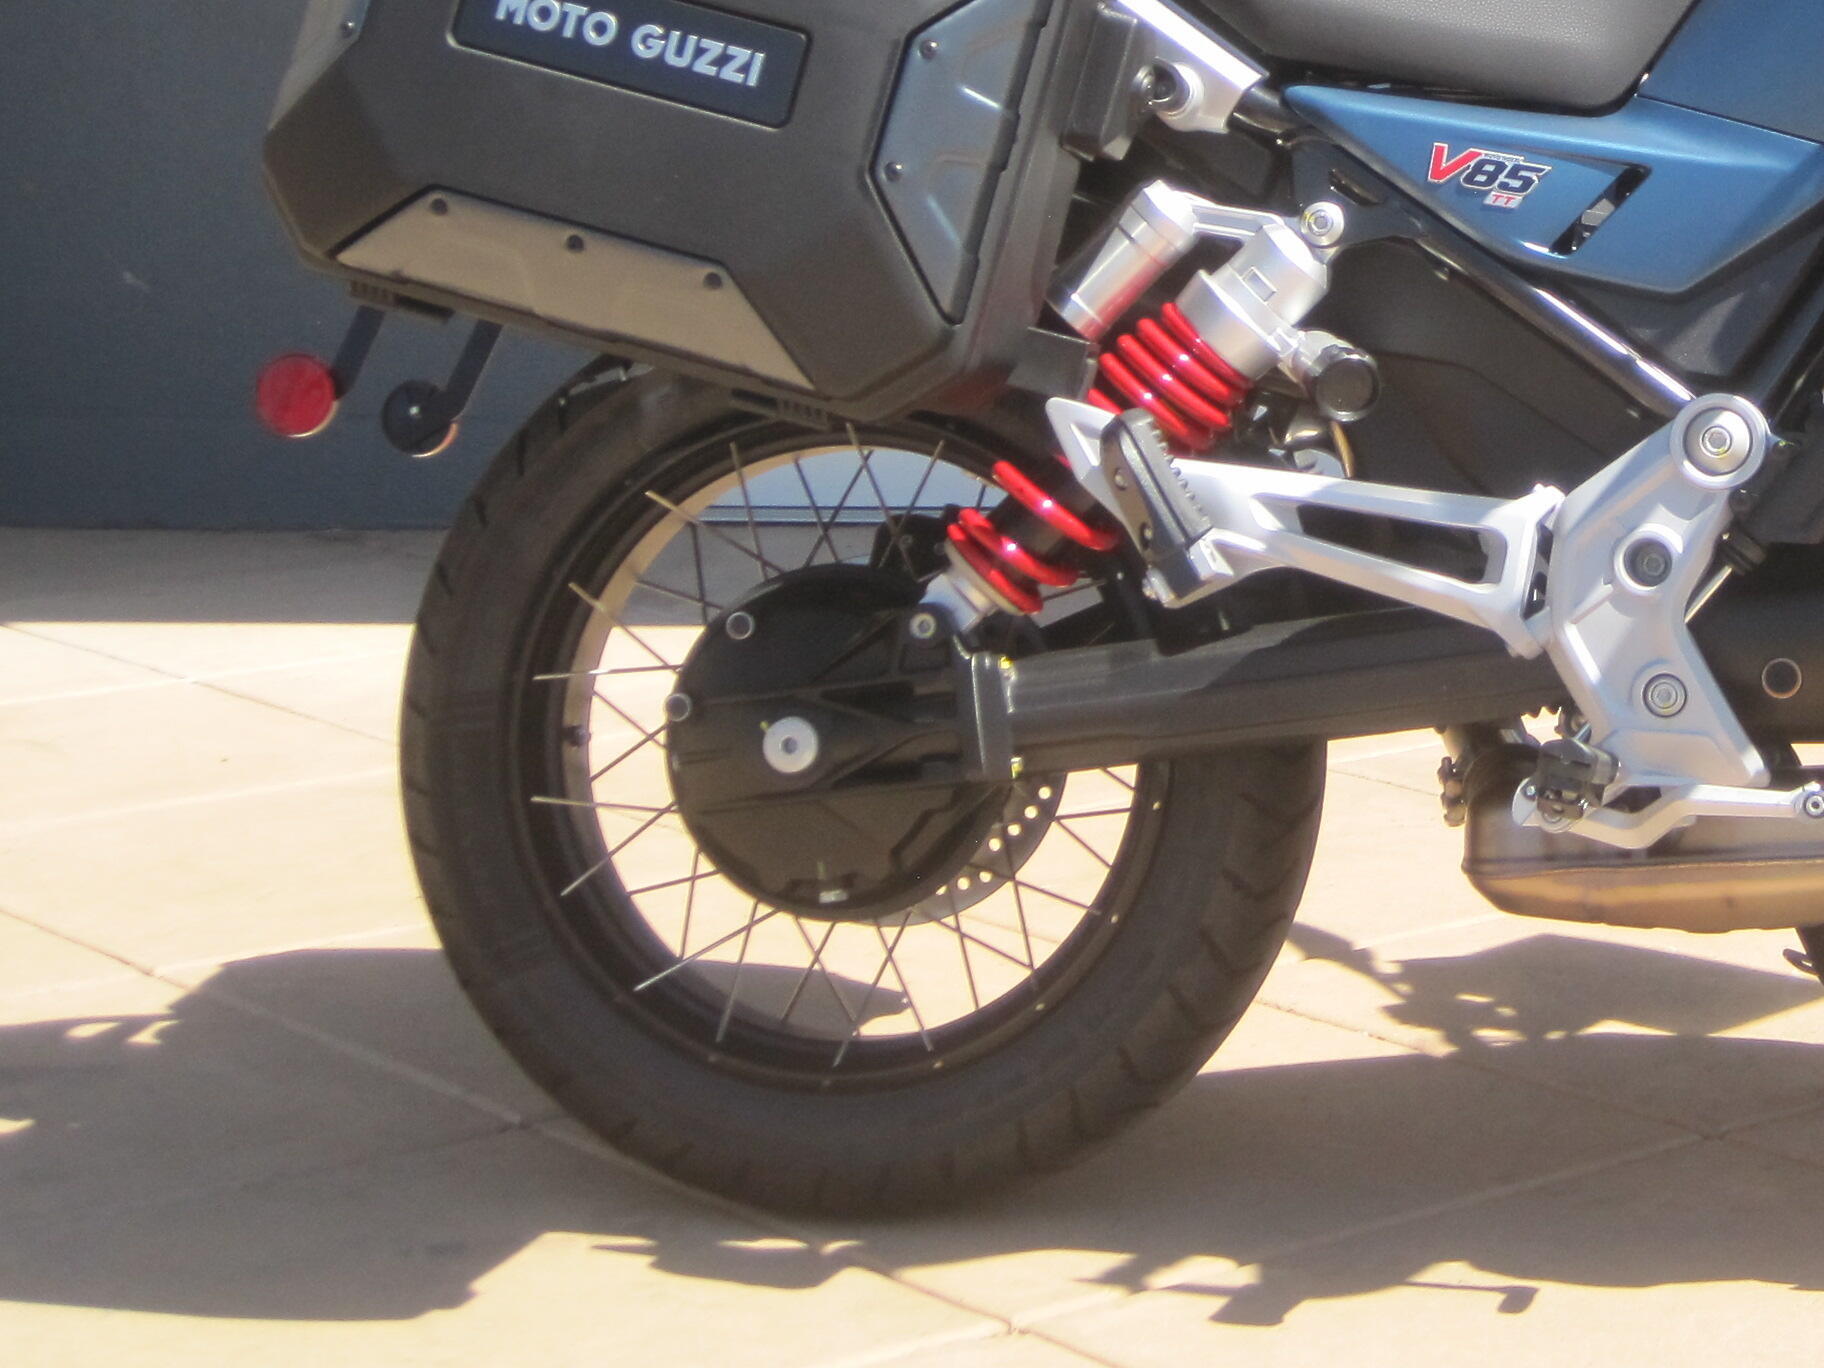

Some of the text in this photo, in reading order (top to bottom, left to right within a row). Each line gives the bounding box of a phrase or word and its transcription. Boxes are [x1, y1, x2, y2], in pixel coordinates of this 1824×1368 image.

[630, 23, 767, 88] GUZZI
[1427, 142, 1552, 196] V85
[1491, 194, 1517, 207] TT
